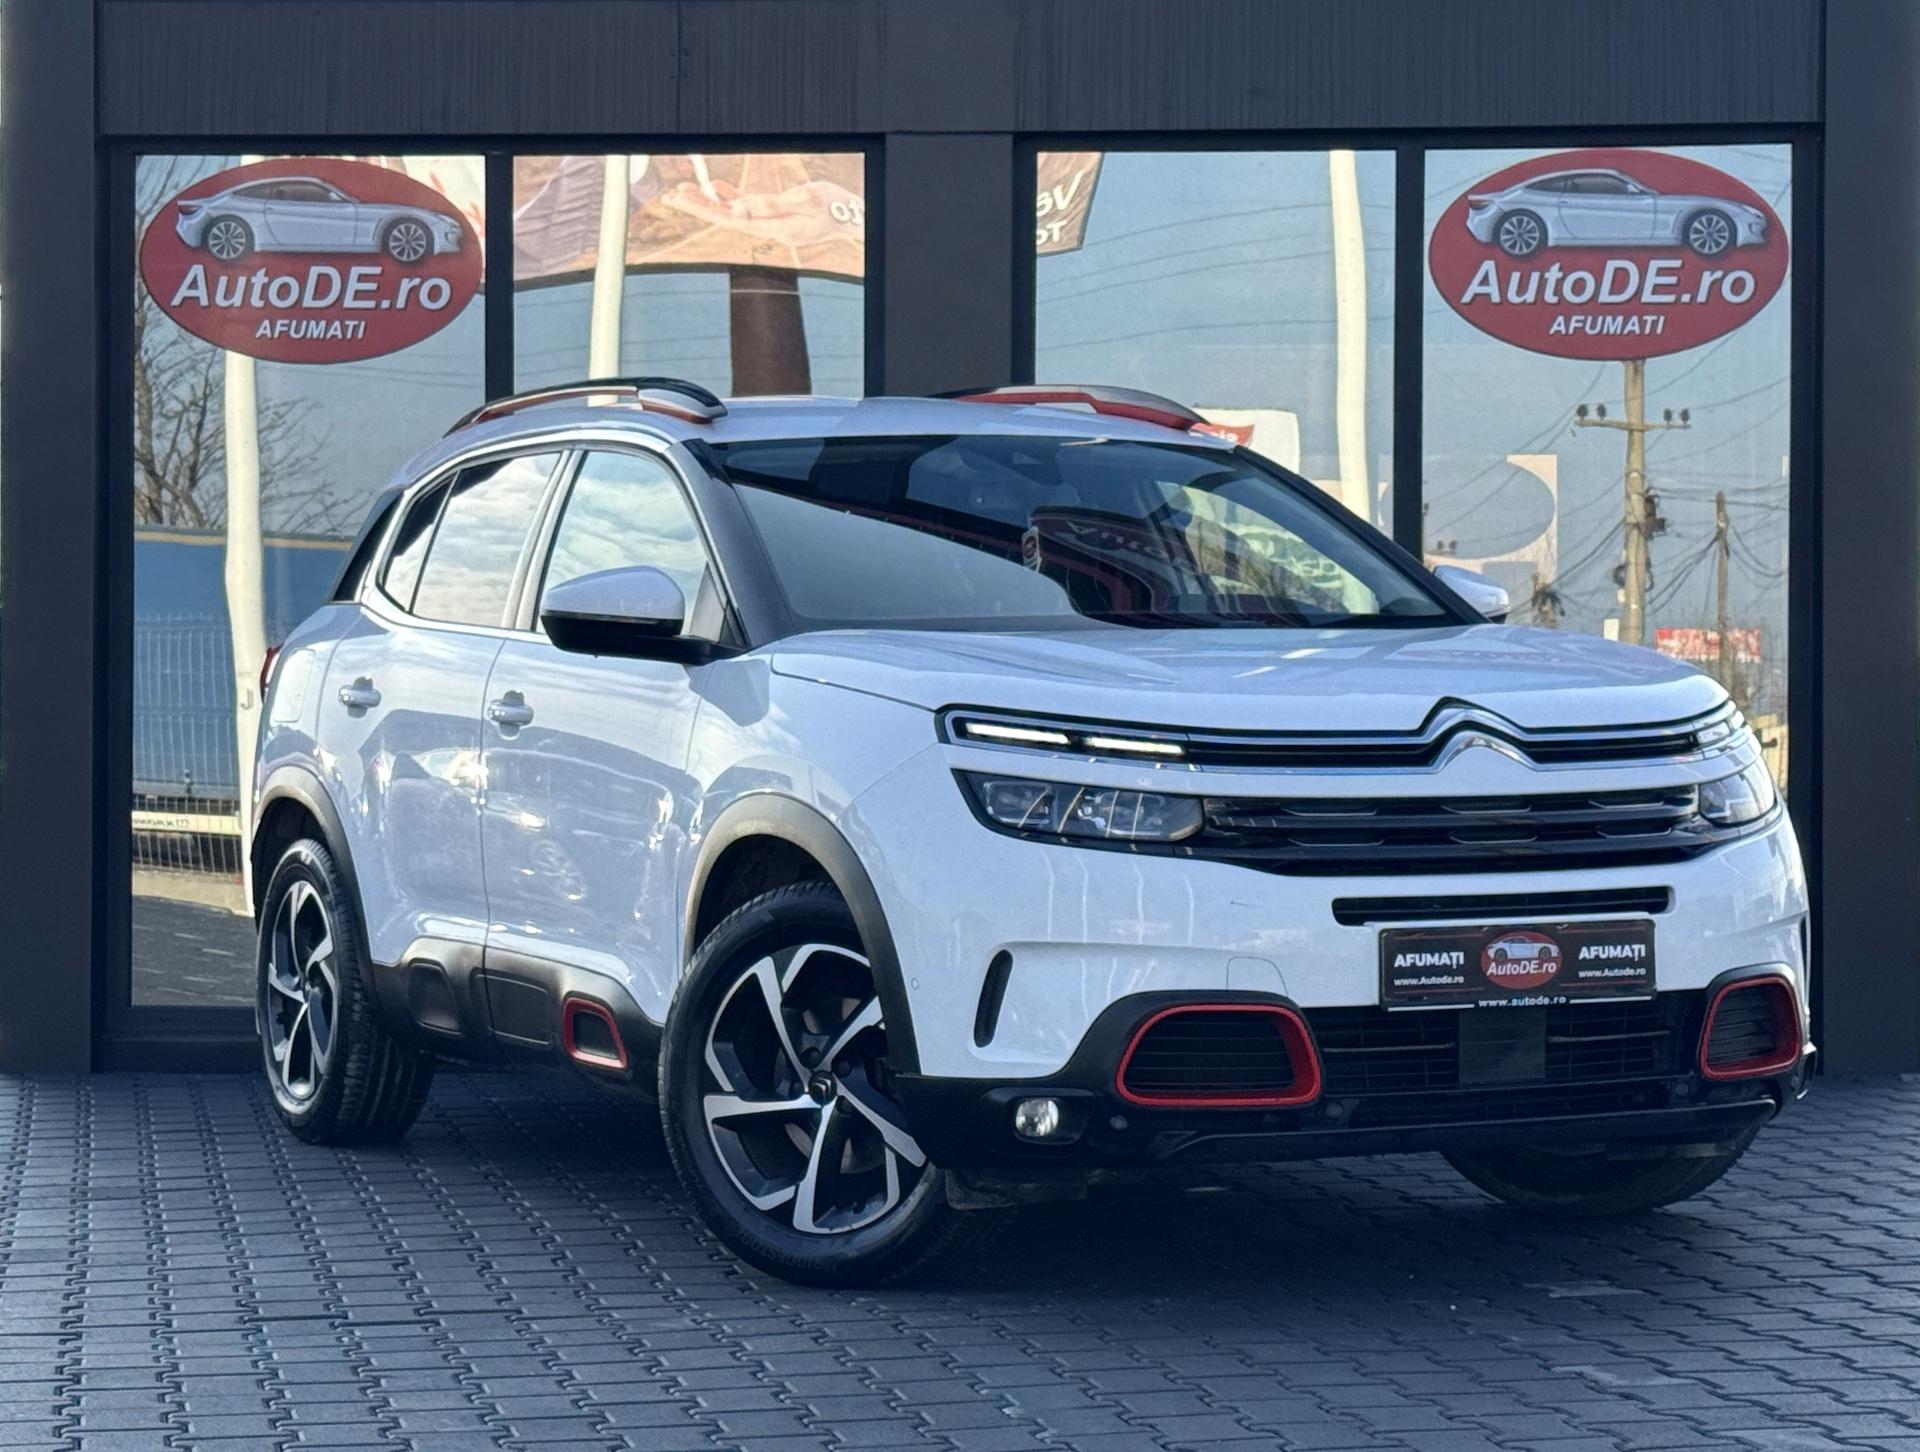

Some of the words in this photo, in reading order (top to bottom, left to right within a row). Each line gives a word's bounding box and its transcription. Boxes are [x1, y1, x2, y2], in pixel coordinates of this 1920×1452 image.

[171, 264, 451, 310] AutoDE.ro
[1461, 260, 1756, 304] AutoDE.ro
[255, 319, 366, 340] AFUMATI
[1549, 315, 1665, 336] AFUMATI
[1486, 959, 1557, 976] AutoDE.ro
[1478, 995, 1567, 1008] www.autode.ro
